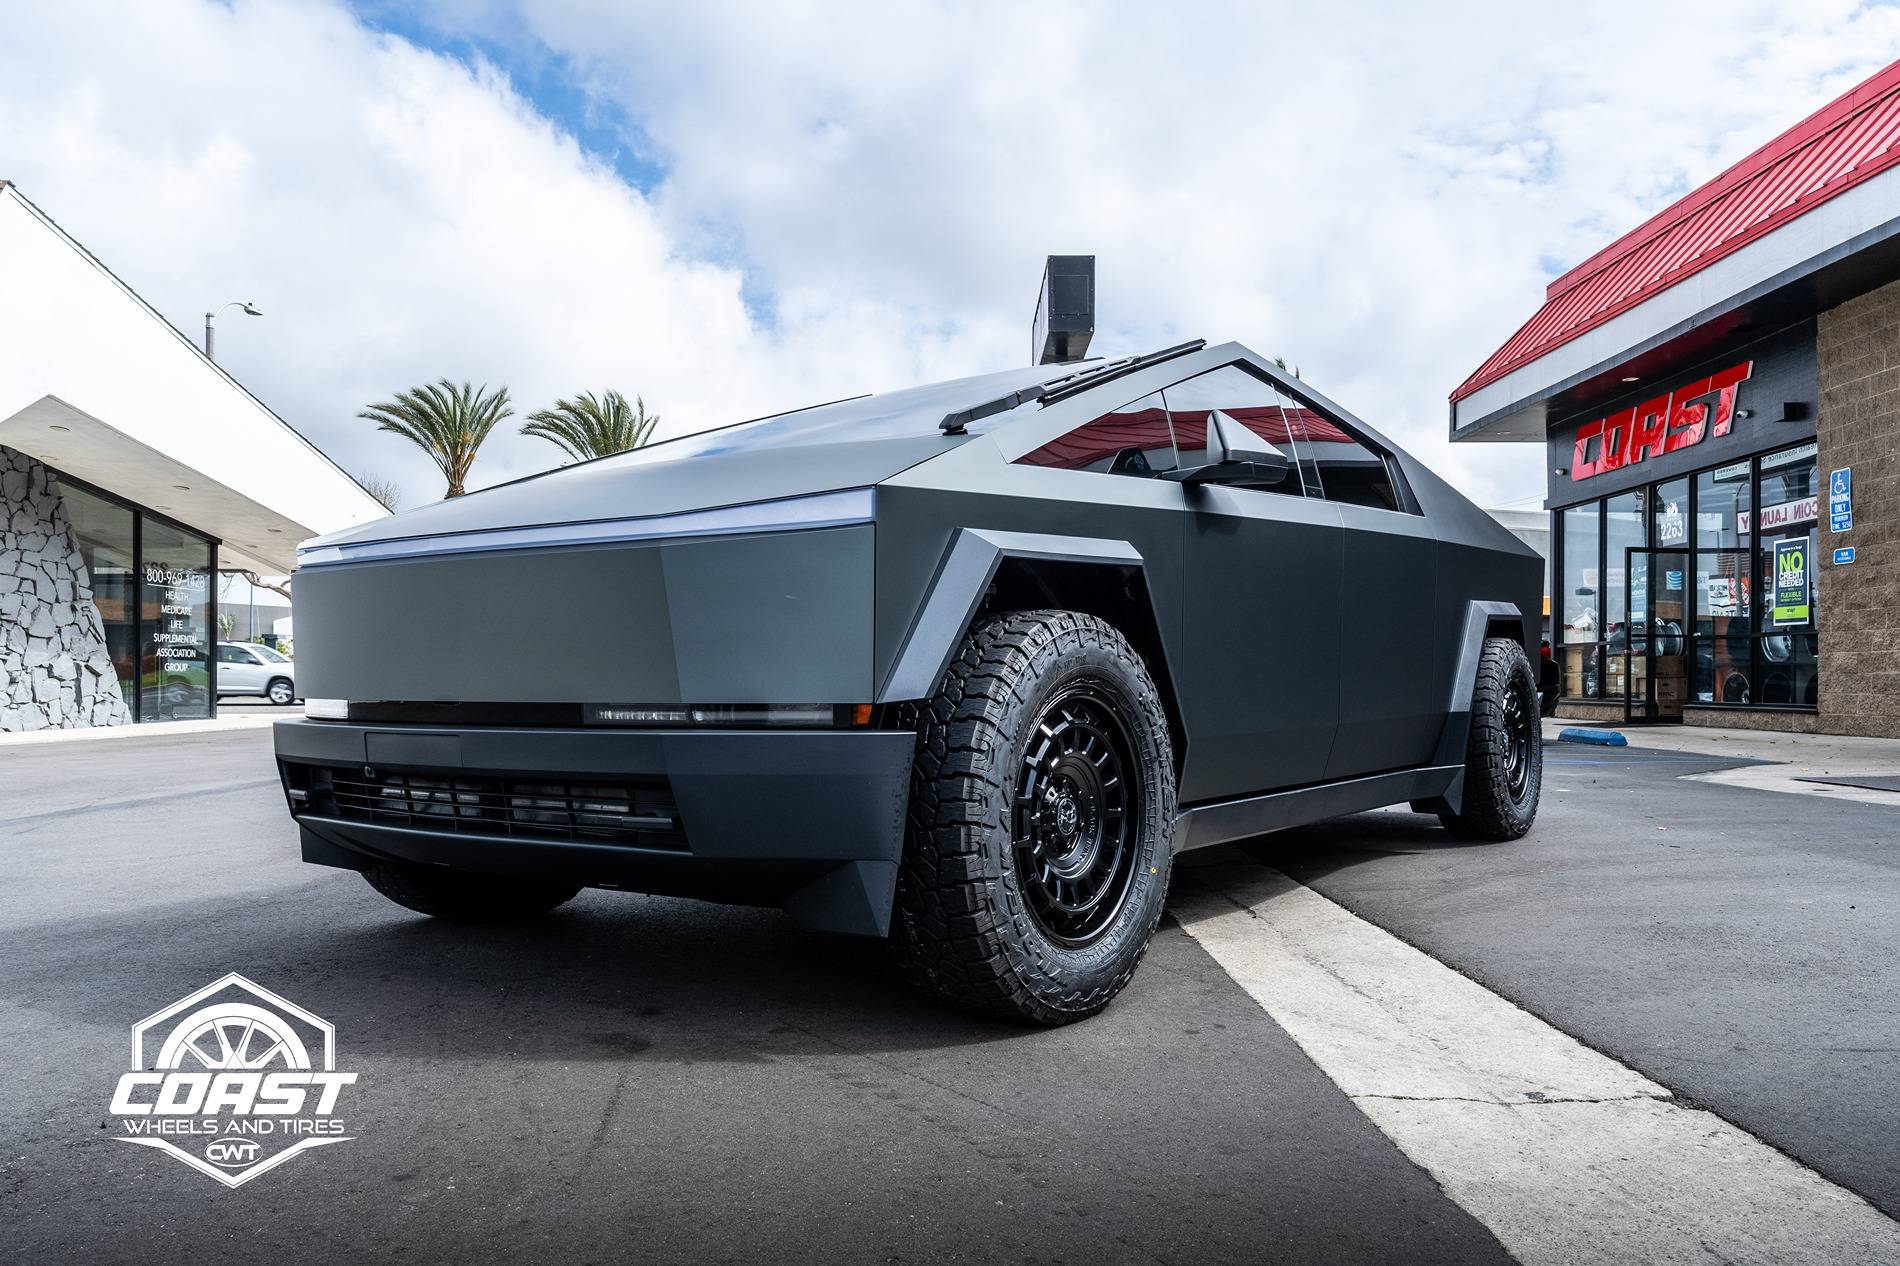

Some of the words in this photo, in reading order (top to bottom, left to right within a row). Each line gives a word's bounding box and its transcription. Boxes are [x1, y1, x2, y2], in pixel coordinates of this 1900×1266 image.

[1571, 360, 1754, 482] COAST
[1831, 492, 1849, 504] PARKING
[1834, 503, 1846, 513] ONLY
[1779, 551, 1804, 573] NO
[1778, 570, 1804, 580] CREDIT
[1778, 579, 1804, 588] NEEDED
[165, 590, 188, 601] HEALTH
[161, 604, 193, 616] MEDICARE
[170, 620, 183, 629] LIFE
[153, 632, 198, 644] SUPPLEMENTAL
[156, 648, 196, 658] ASSOCIATION
[164, 662, 188, 672] GROUP
